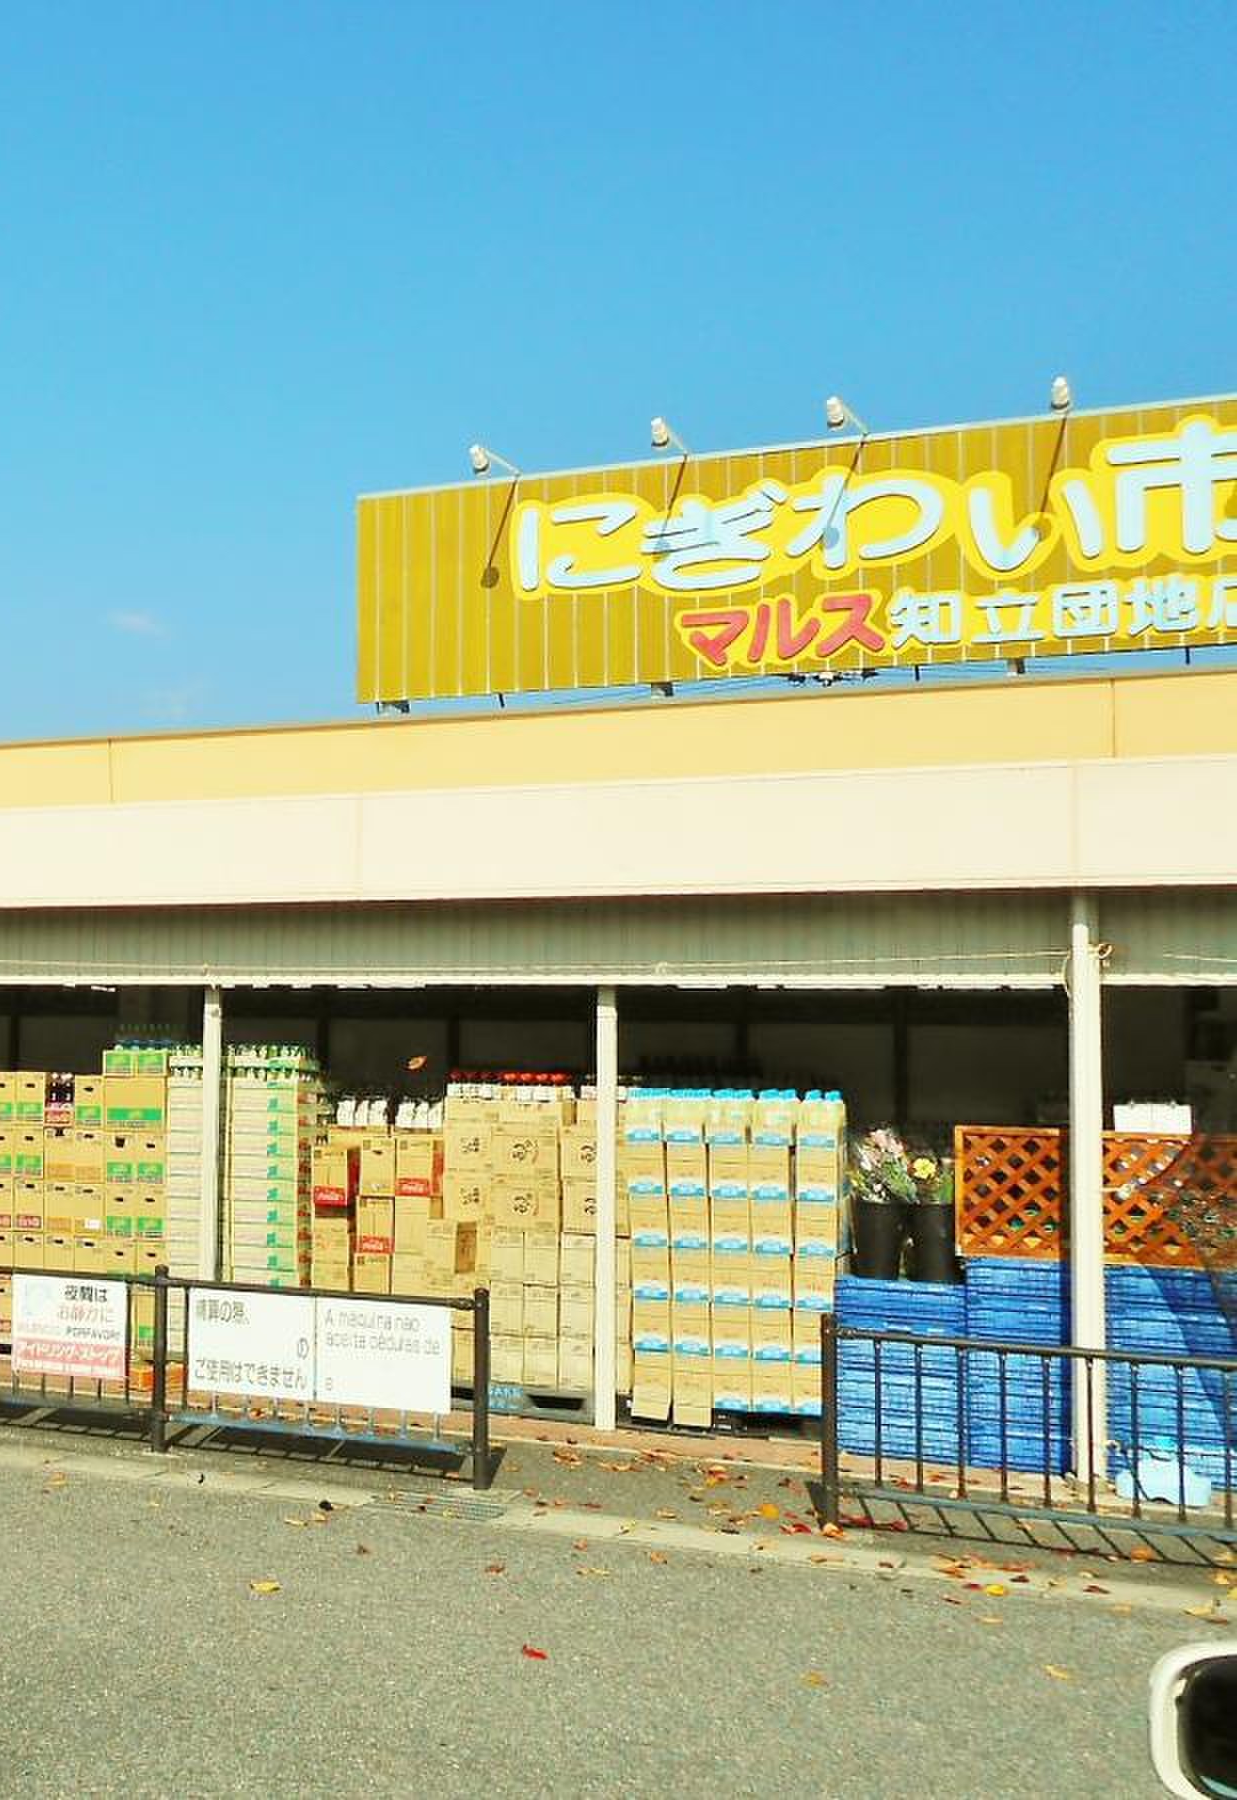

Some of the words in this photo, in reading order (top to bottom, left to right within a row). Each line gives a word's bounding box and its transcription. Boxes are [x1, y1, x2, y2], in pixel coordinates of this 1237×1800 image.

[681, 593, 884, 663] マルス
[324, 1308, 334, 1326] A
